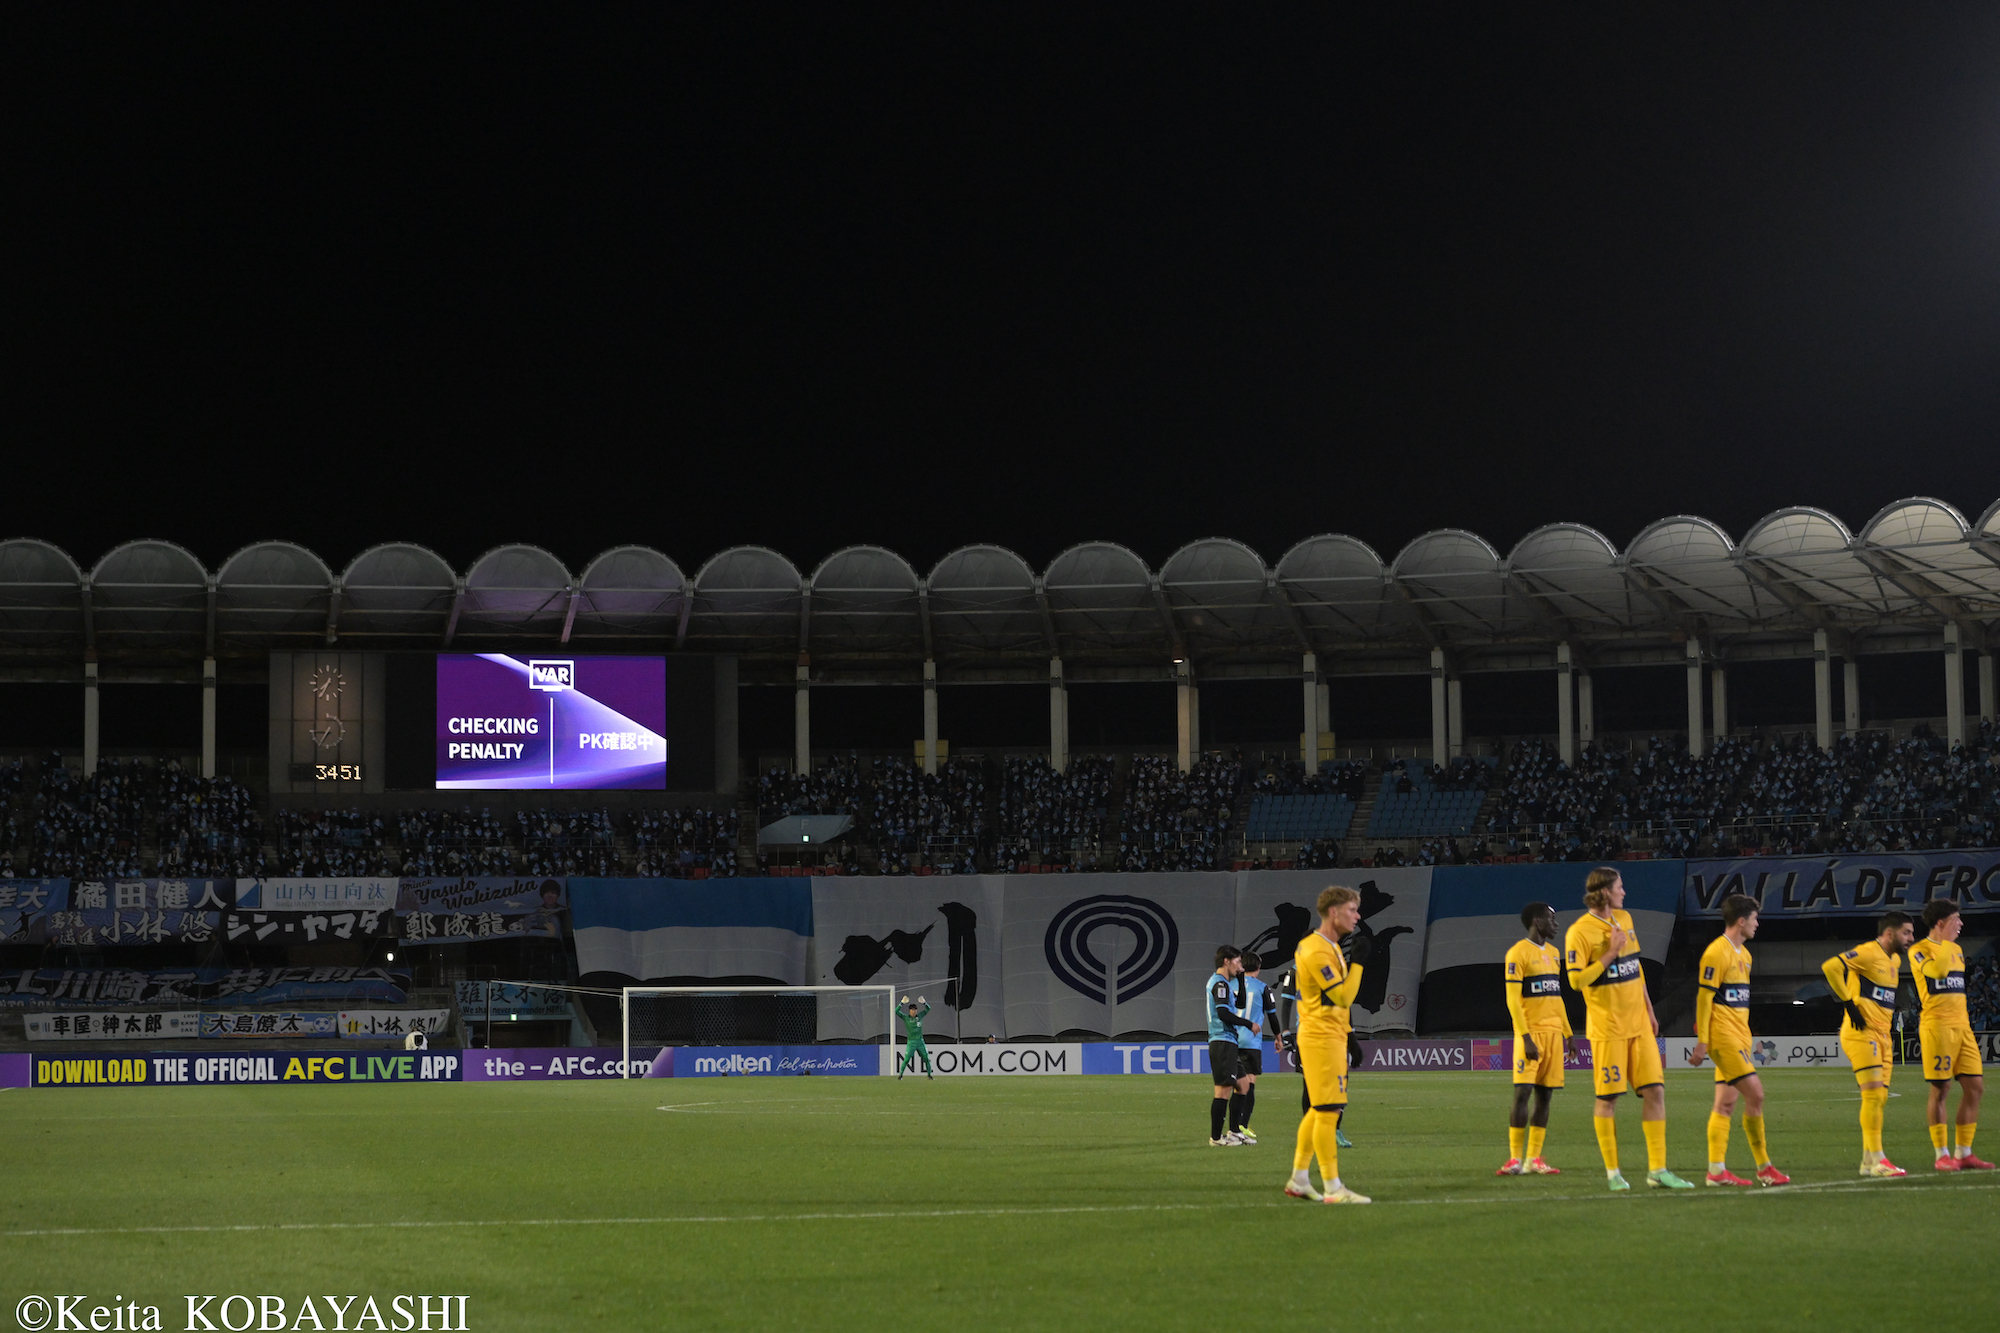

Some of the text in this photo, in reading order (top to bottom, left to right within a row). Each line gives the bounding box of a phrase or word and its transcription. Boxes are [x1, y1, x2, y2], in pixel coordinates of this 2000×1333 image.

[535, 668, 570, 682] VAR
[448, 717, 540, 734] CHECKING
[580, 733, 654, 750] PK確認中
[449, 743, 525, 759] PENALTY
[276, 883, 385, 900] 山内日向汰
[415, 878, 477, 905] Yasuto
[1782, 860, 1838, 908] LÁ
[1854, 868, 1912, 905] DE
[75, 880, 227, 910] 橘田健人
[442, 880, 539, 909] Wakizaka
[1371, 1047, 1465, 1066] AIRWAYS
[1788, 1042, 1839, 1063] نيوم
[1869, 1041, 1877, 1056] 7
[37, 1055, 458, 1084] DOWNLOAD THE OFFICIAL AFC LIVE APP
[484, 1058, 525, 1076] the
[546, 1056, 653, 1076] AFC.com
[695, 1055, 771, 1073] molten
[1517, 1059, 1525, 1073] 9
[1934, 1055, 1951, 1071] 23
[1602, 1066, 1621, 1084] 33
